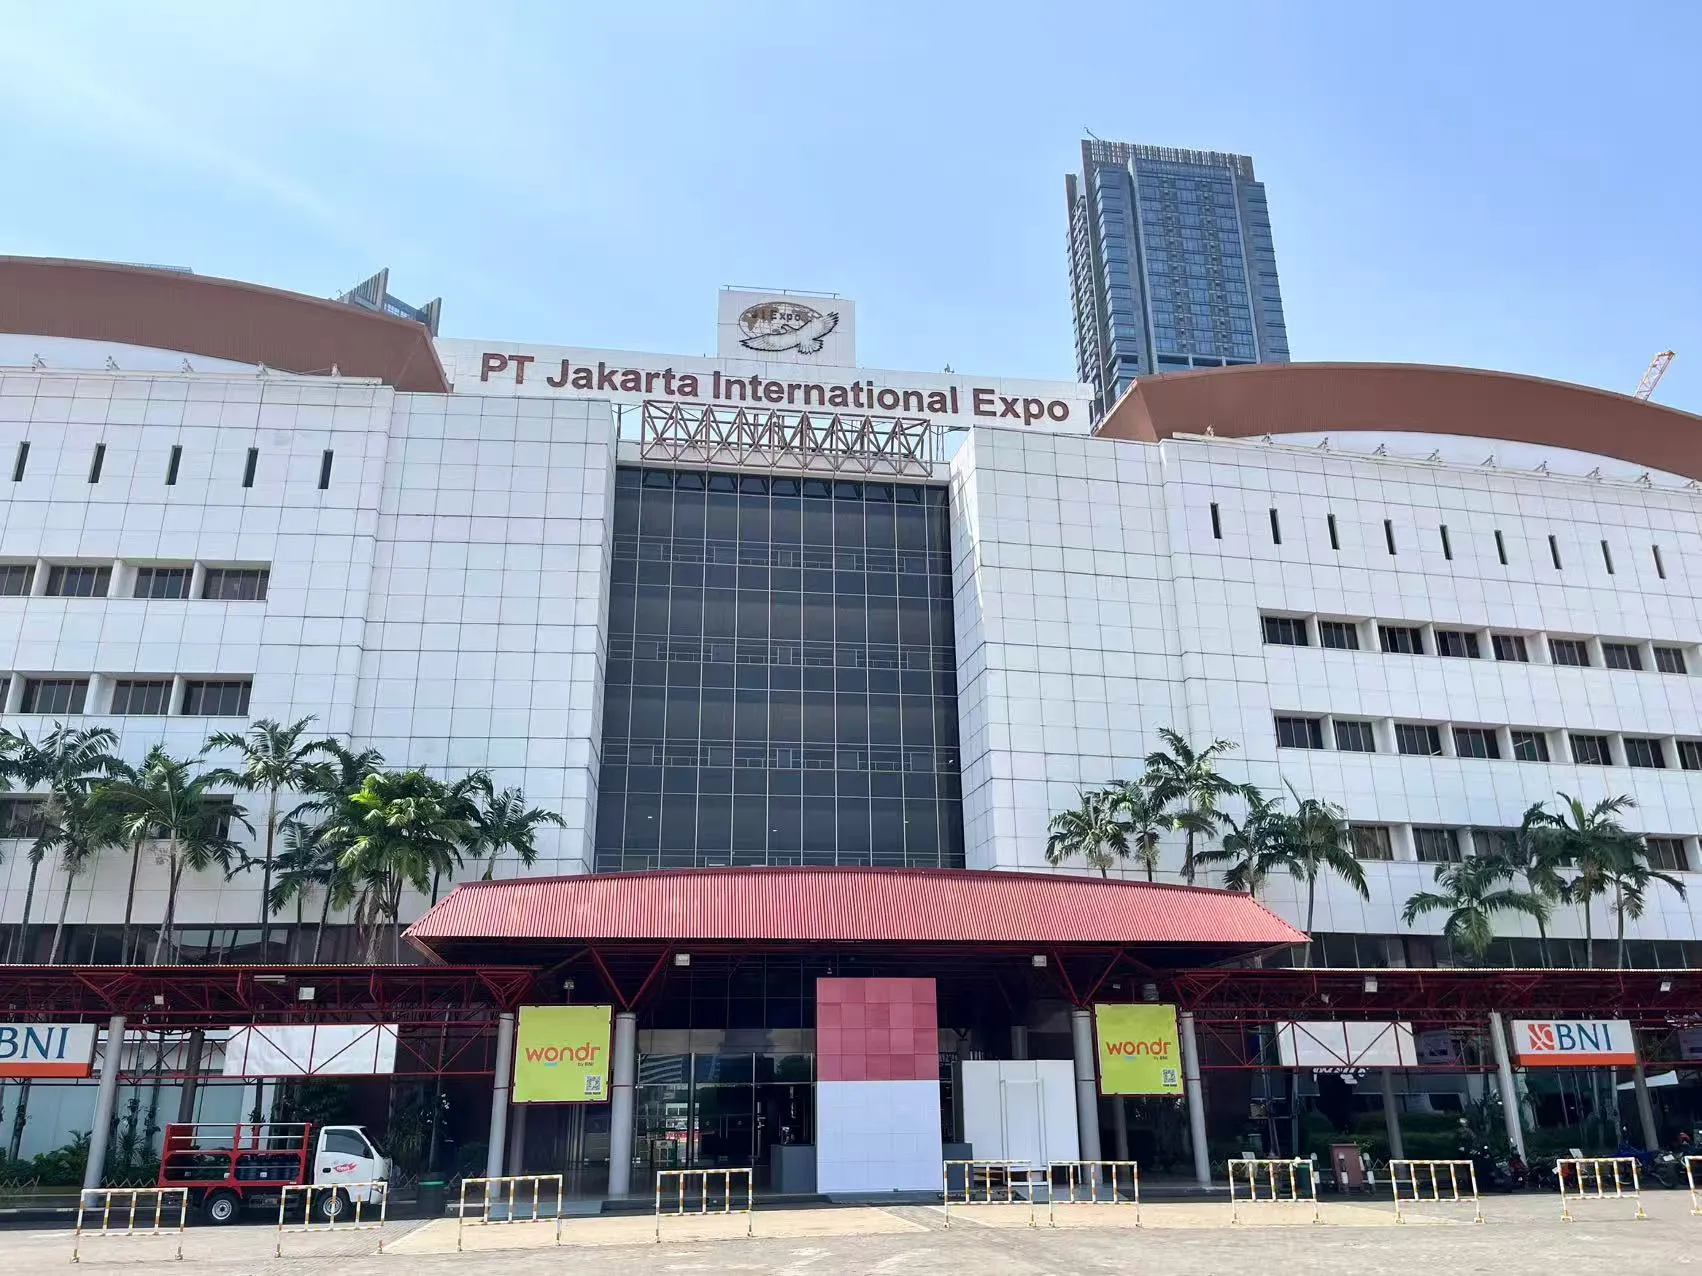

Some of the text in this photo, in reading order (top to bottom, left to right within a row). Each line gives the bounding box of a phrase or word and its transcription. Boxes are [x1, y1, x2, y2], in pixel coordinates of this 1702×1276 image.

[481, 353, 1070, 425] PT Jakarta International Expo
[0, 1026, 70, 1059] BNI
[1106, 1038, 1171, 1055] wondr
[1555, 1023, 1612, 1051] BNI
[525, 1042, 601, 1062] wondr
